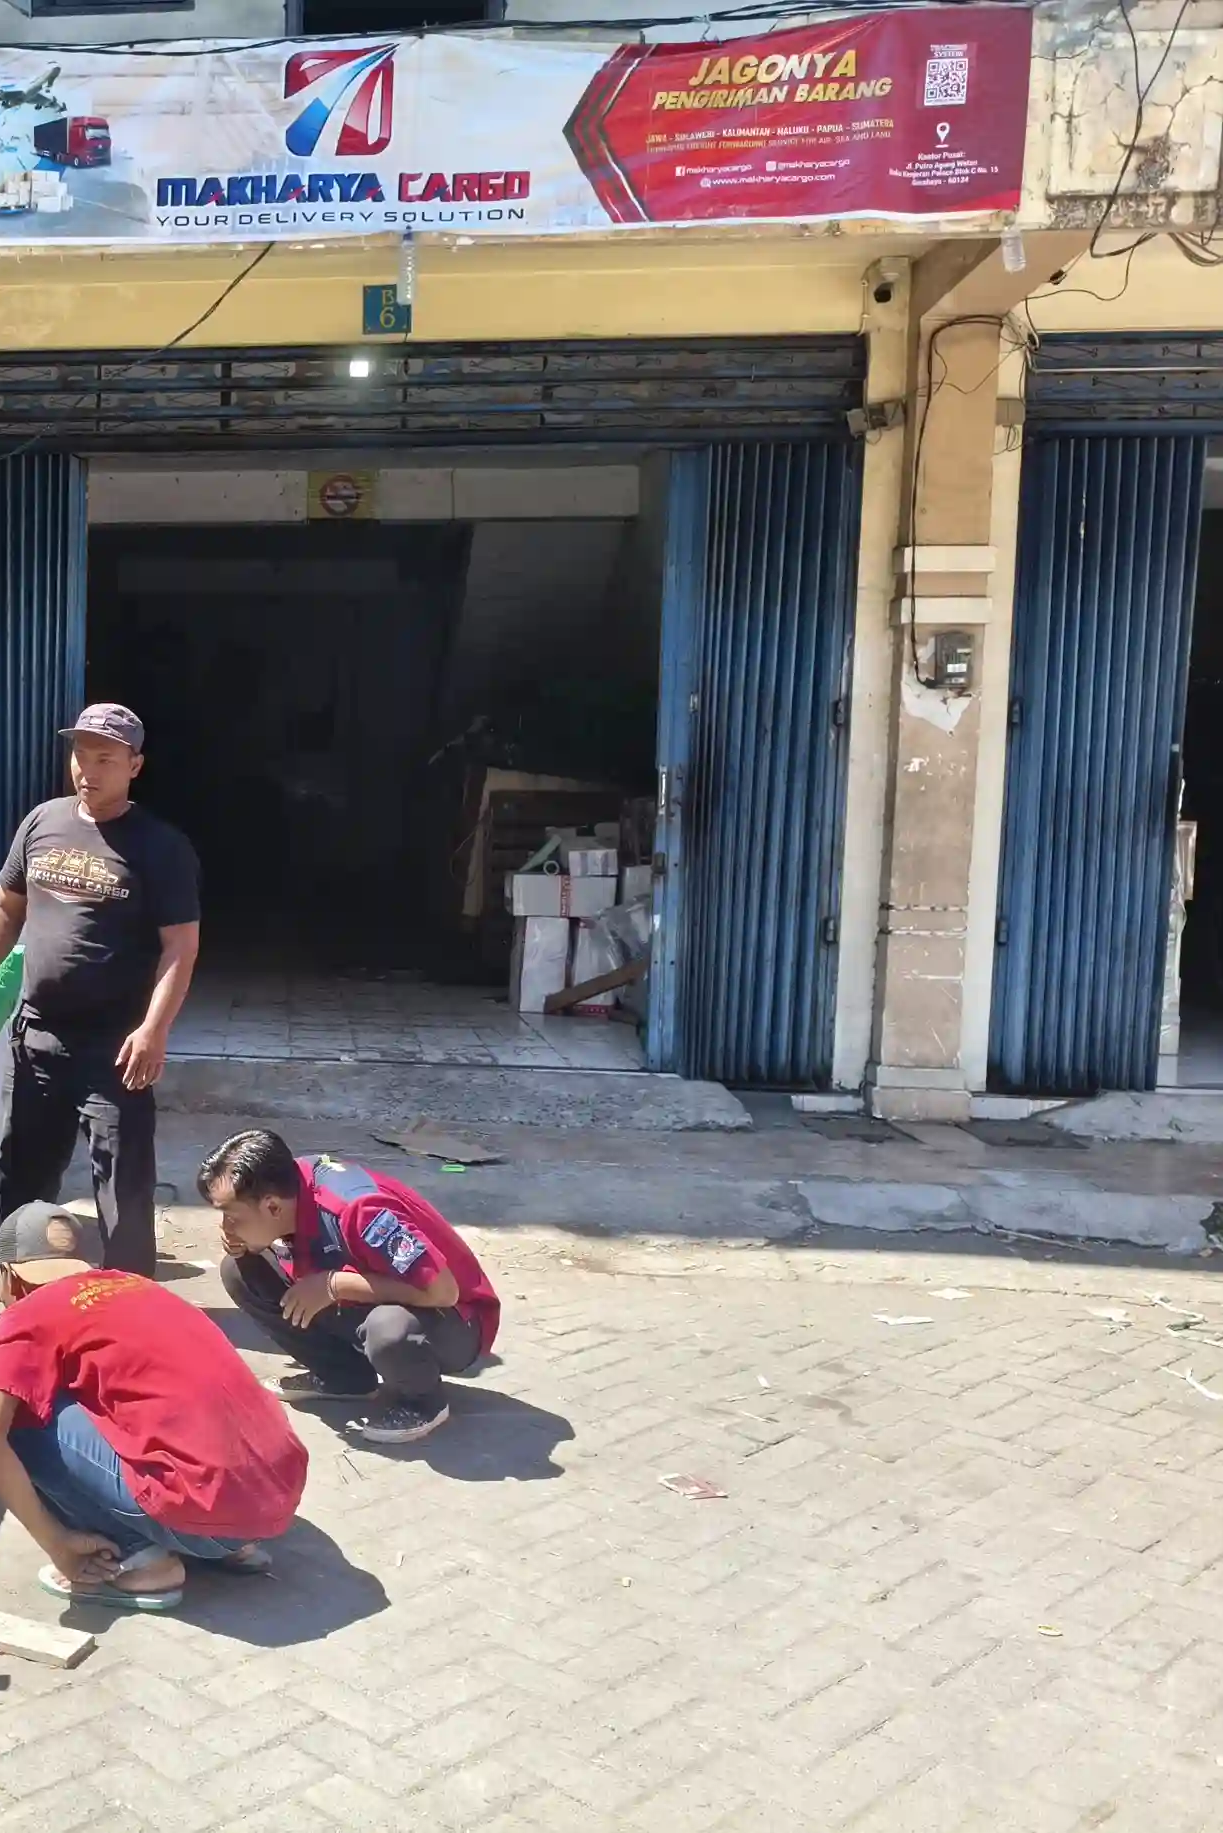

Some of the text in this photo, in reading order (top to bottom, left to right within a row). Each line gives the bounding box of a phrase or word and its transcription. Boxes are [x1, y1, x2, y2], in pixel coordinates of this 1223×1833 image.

[689, 49, 857, 87] JAGONYA
[652, 77, 893, 111] PENGIRIMAN BARANG
[817, 124, 843, 133] PAPUA
[852, 119, 893, 131] SUMATERA
[686, 164, 753, 174] makharyacargo
[157, 171, 530, 207] MAKHARYA CARGO
[712, 174, 835, 185] www.makharyacargo.com
[156, 209, 524, 226] YOUR DELIVERY SOLUTION
[379, 306, 395, 328] 6
